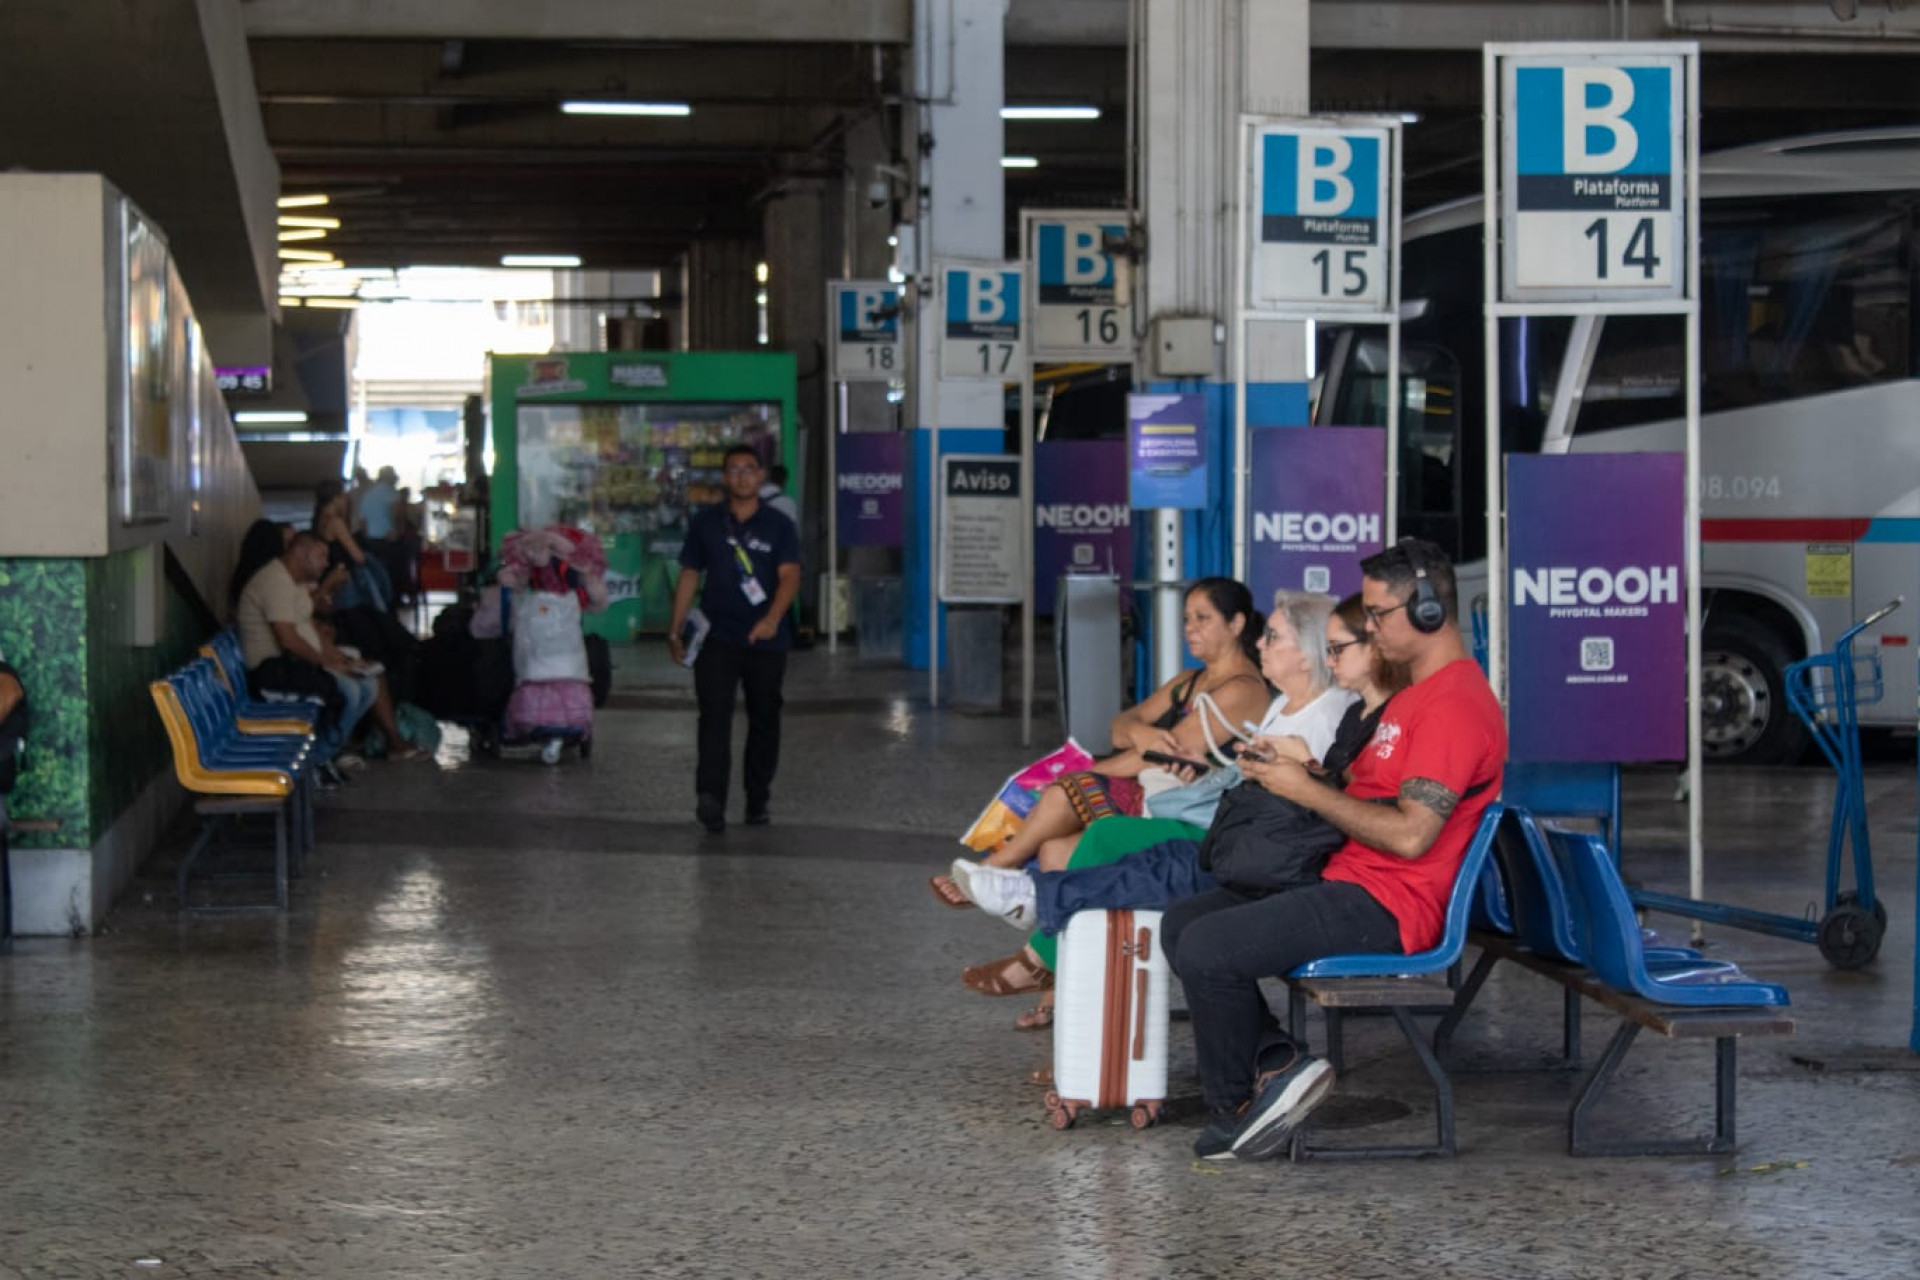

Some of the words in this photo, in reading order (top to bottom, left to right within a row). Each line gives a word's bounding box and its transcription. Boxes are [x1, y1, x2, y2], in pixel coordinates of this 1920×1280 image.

[1562, 66, 1639, 175] B
[1296, 135, 1355, 217] B
[1573, 178, 1660, 196] Plataforma
[1615, 196, 1660, 208] Platform
[1303, 218, 1370, 234] Plataforma
[1065, 224, 1107, 285] B
[1584, 217, 1661, 280] 14
[1311, 249, 1368, 297] 15
[857, 291, 886, 331] B
[968, 271, 1006, 323] B
[1076, 309, 1119, 345] 16
[865, 346, 895, 370] 18
[977, 344, 1014, 373] 17
[838, 473, 903, 490] NEOOH
[953, 467, 1012, 491] Aviso
[1036, 504, 1131, 528] NEOOH
[1254, 512, 1380, 542] NEOOH
[1513, 566, 1678, 606] NEOOH
[1549, 607, 1602, 618] PHYGITAL
[1603, 606, 1649, 617] MAKERS
